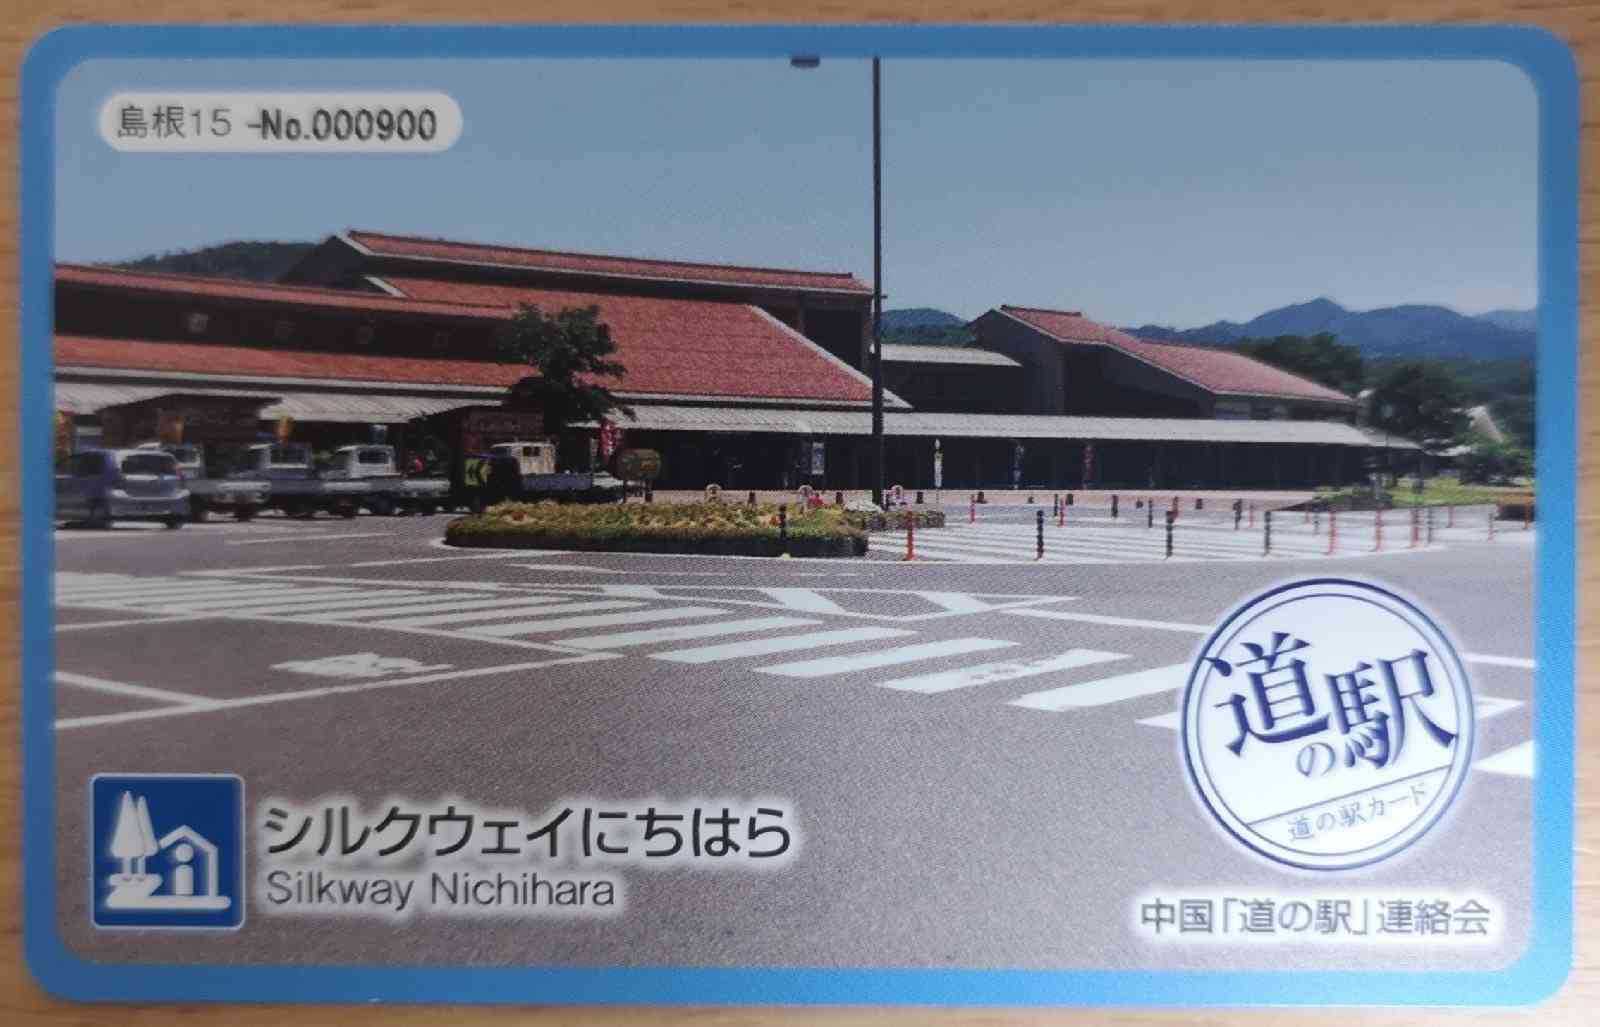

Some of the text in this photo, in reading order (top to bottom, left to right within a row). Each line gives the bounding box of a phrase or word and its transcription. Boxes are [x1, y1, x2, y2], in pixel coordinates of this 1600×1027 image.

[116, 104, 232, 139] 島根15
[1202, 631, 1457, 777] 道の駅
[264, 805, 791, 858] シルクウェイにちはら
[1287, 782, 1427, 842] 道の駅カード
[266, 870, 615, 911] Silkway Nichihara
[1140, 897, 1491, 936] 中国「道の駅」連絡会
